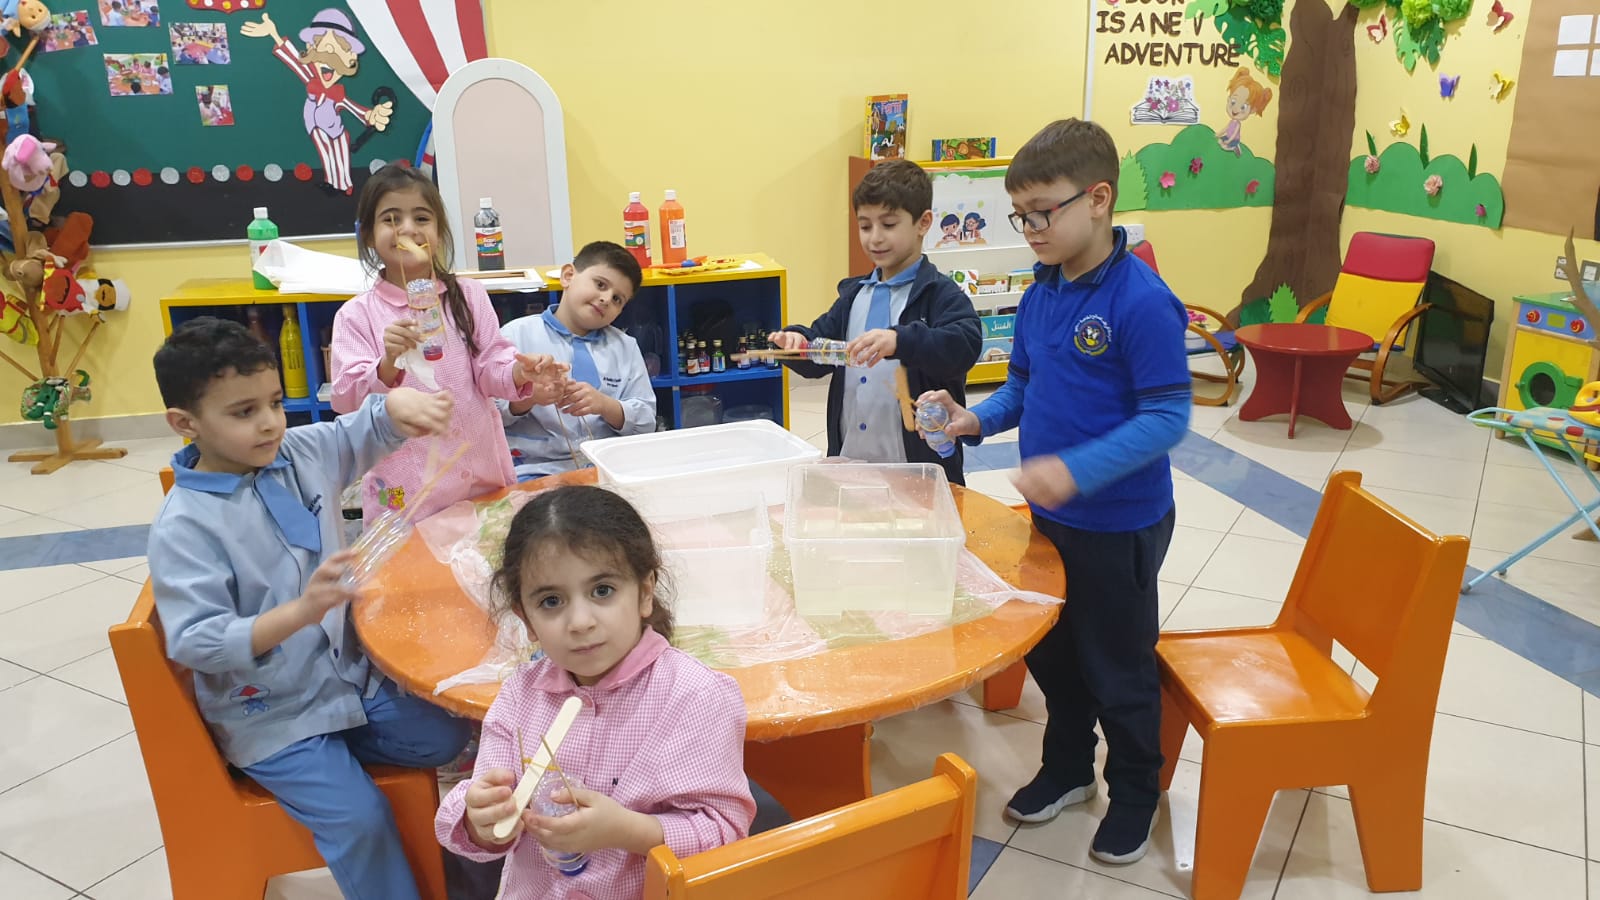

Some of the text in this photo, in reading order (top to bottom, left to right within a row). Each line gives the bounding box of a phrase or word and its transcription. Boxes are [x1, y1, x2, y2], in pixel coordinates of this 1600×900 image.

[1096, 10, 1126, 34] IS
[1129, 11, 1146, 33] A
[1104, 42, 1241, 67] ADVENTURE
